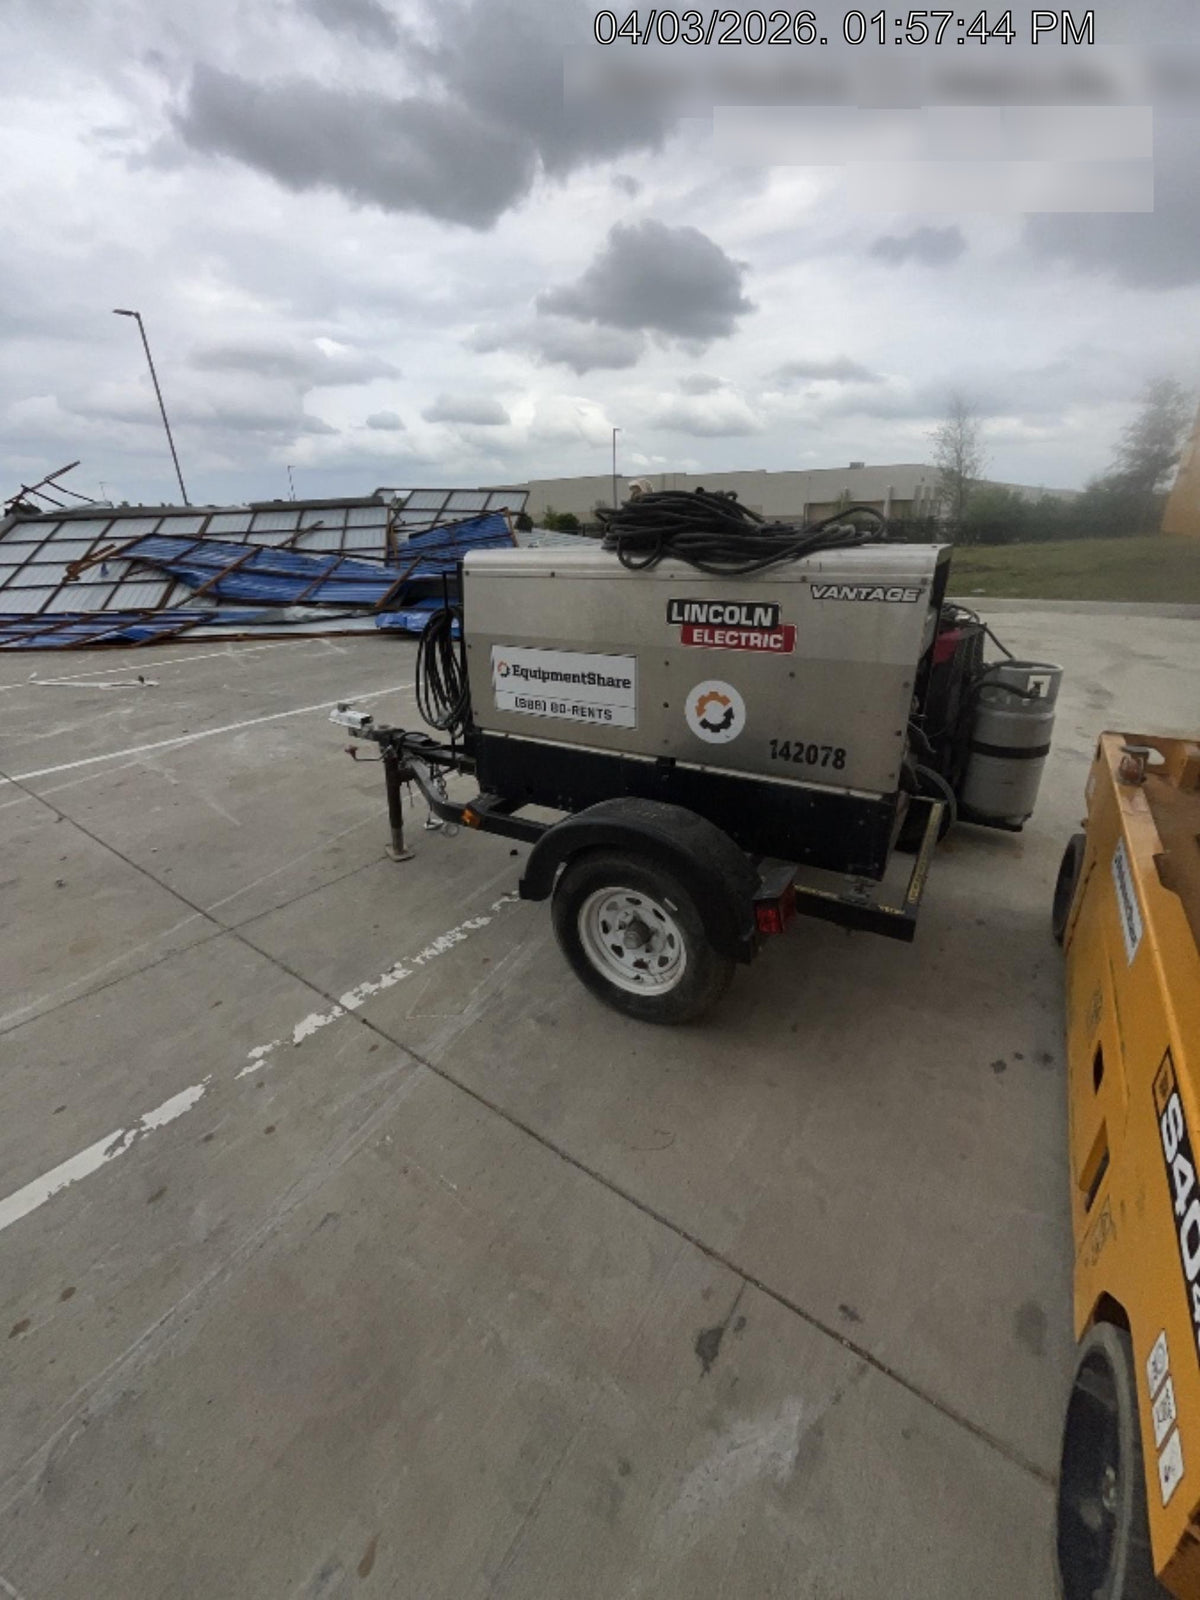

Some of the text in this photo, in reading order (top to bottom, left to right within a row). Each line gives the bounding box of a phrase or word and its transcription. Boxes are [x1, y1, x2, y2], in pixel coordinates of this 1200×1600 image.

[811, 584, 922, 602] VANTAGE
[671, 602, 774, 627] LINCOLN
[692, 629, 784, 649] ELECTRIC
[511, 664, 632, 689] EquipmentShare
[769, 739, 847, 770] 142078
[1160, 1092, 1200, 1354] S40
